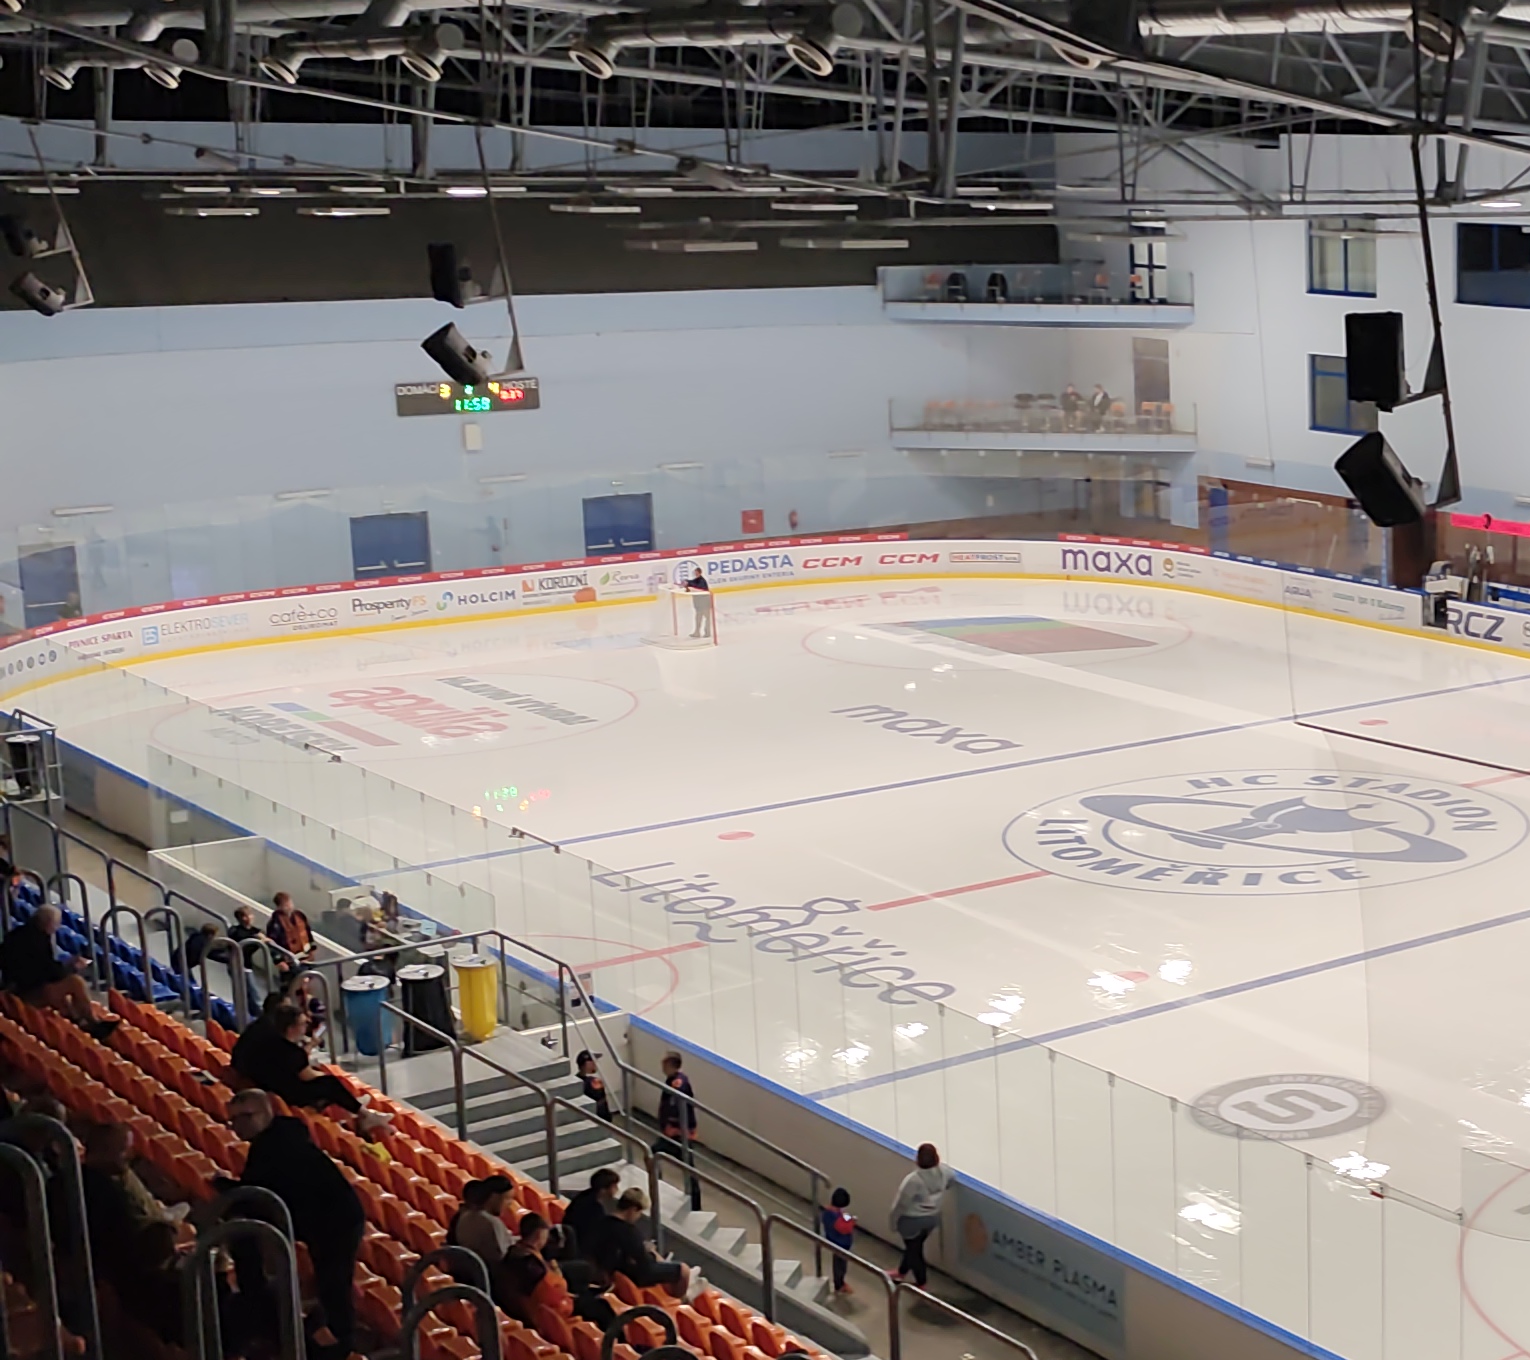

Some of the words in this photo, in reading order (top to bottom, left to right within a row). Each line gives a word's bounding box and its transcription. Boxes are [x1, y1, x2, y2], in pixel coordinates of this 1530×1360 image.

[707, 554, 794, 575] PEDASTA
[802, 556, 863, 569] CCM
[879, 553, 940, 565] CCM
[1061, 548, 1153, 576] maxa
[458, 590, 516, 605] HOLCIM
[161, 612, 249, 636] ELEKTROSEVER
[328, 686, 510, 739] aprilia
[829, 704, 1023, 754] maxa
[1186, 774, 1278, 790] HC
[1304, 774, 1497, 833] STADION
[1036, 817, 1371, 886] LITOMĚŘICE
[991, 1230, 1045, 1265] AMBER
[1053, 1259, 1118, 1307] PLASMA
